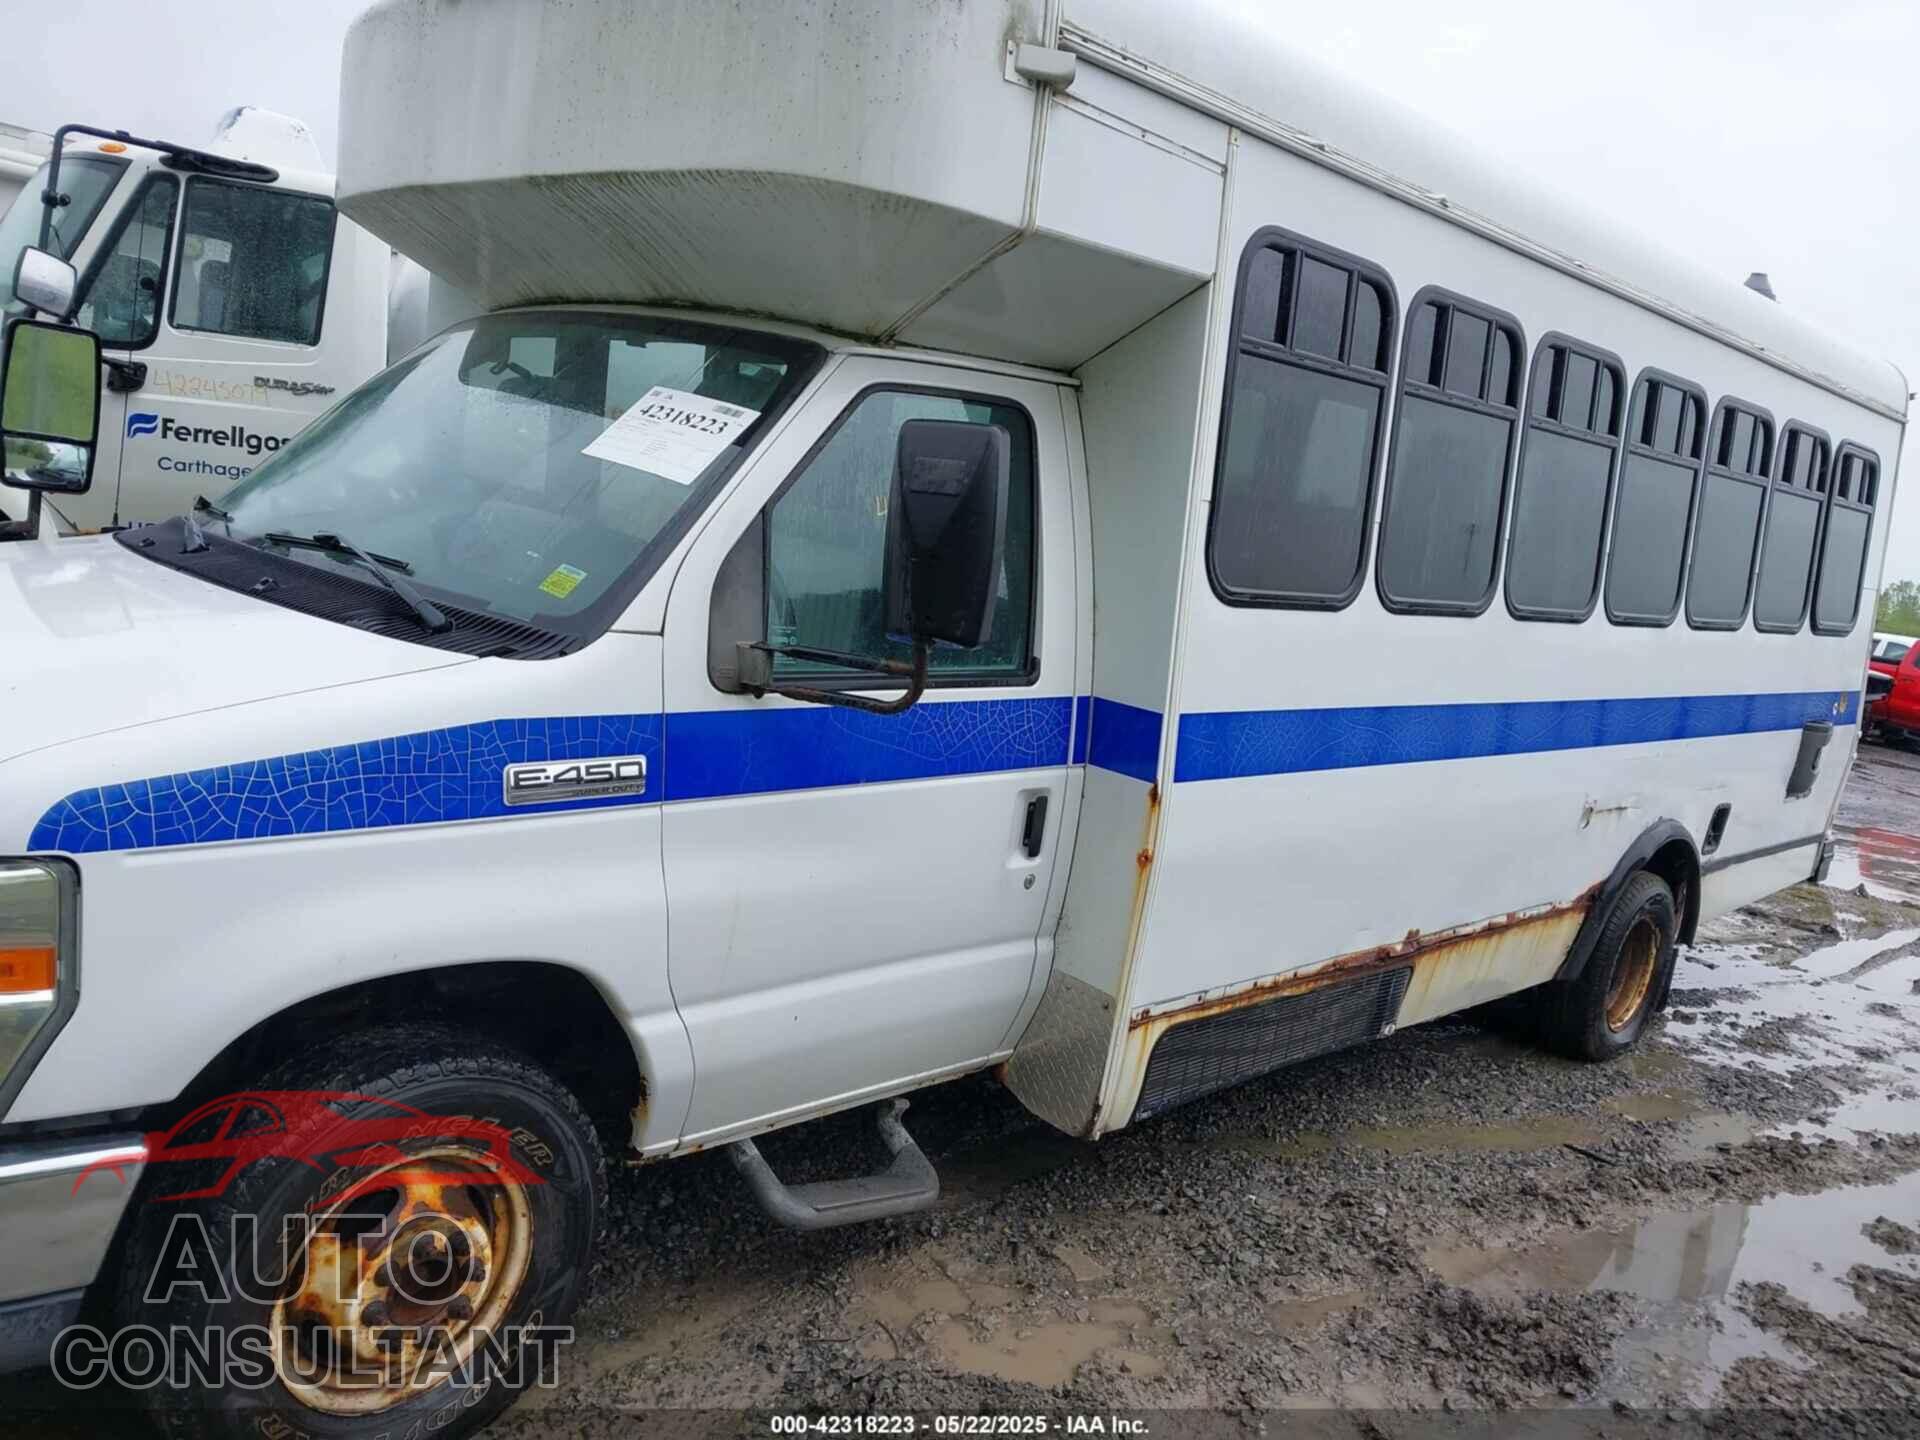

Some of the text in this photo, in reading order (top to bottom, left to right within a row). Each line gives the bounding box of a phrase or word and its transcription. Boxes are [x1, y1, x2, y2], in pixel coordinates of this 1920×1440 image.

[639, 403, 729, 435] 42318223
[157, 456, 253, 480] Carthage
[512, 761, 644, 790] E-450
